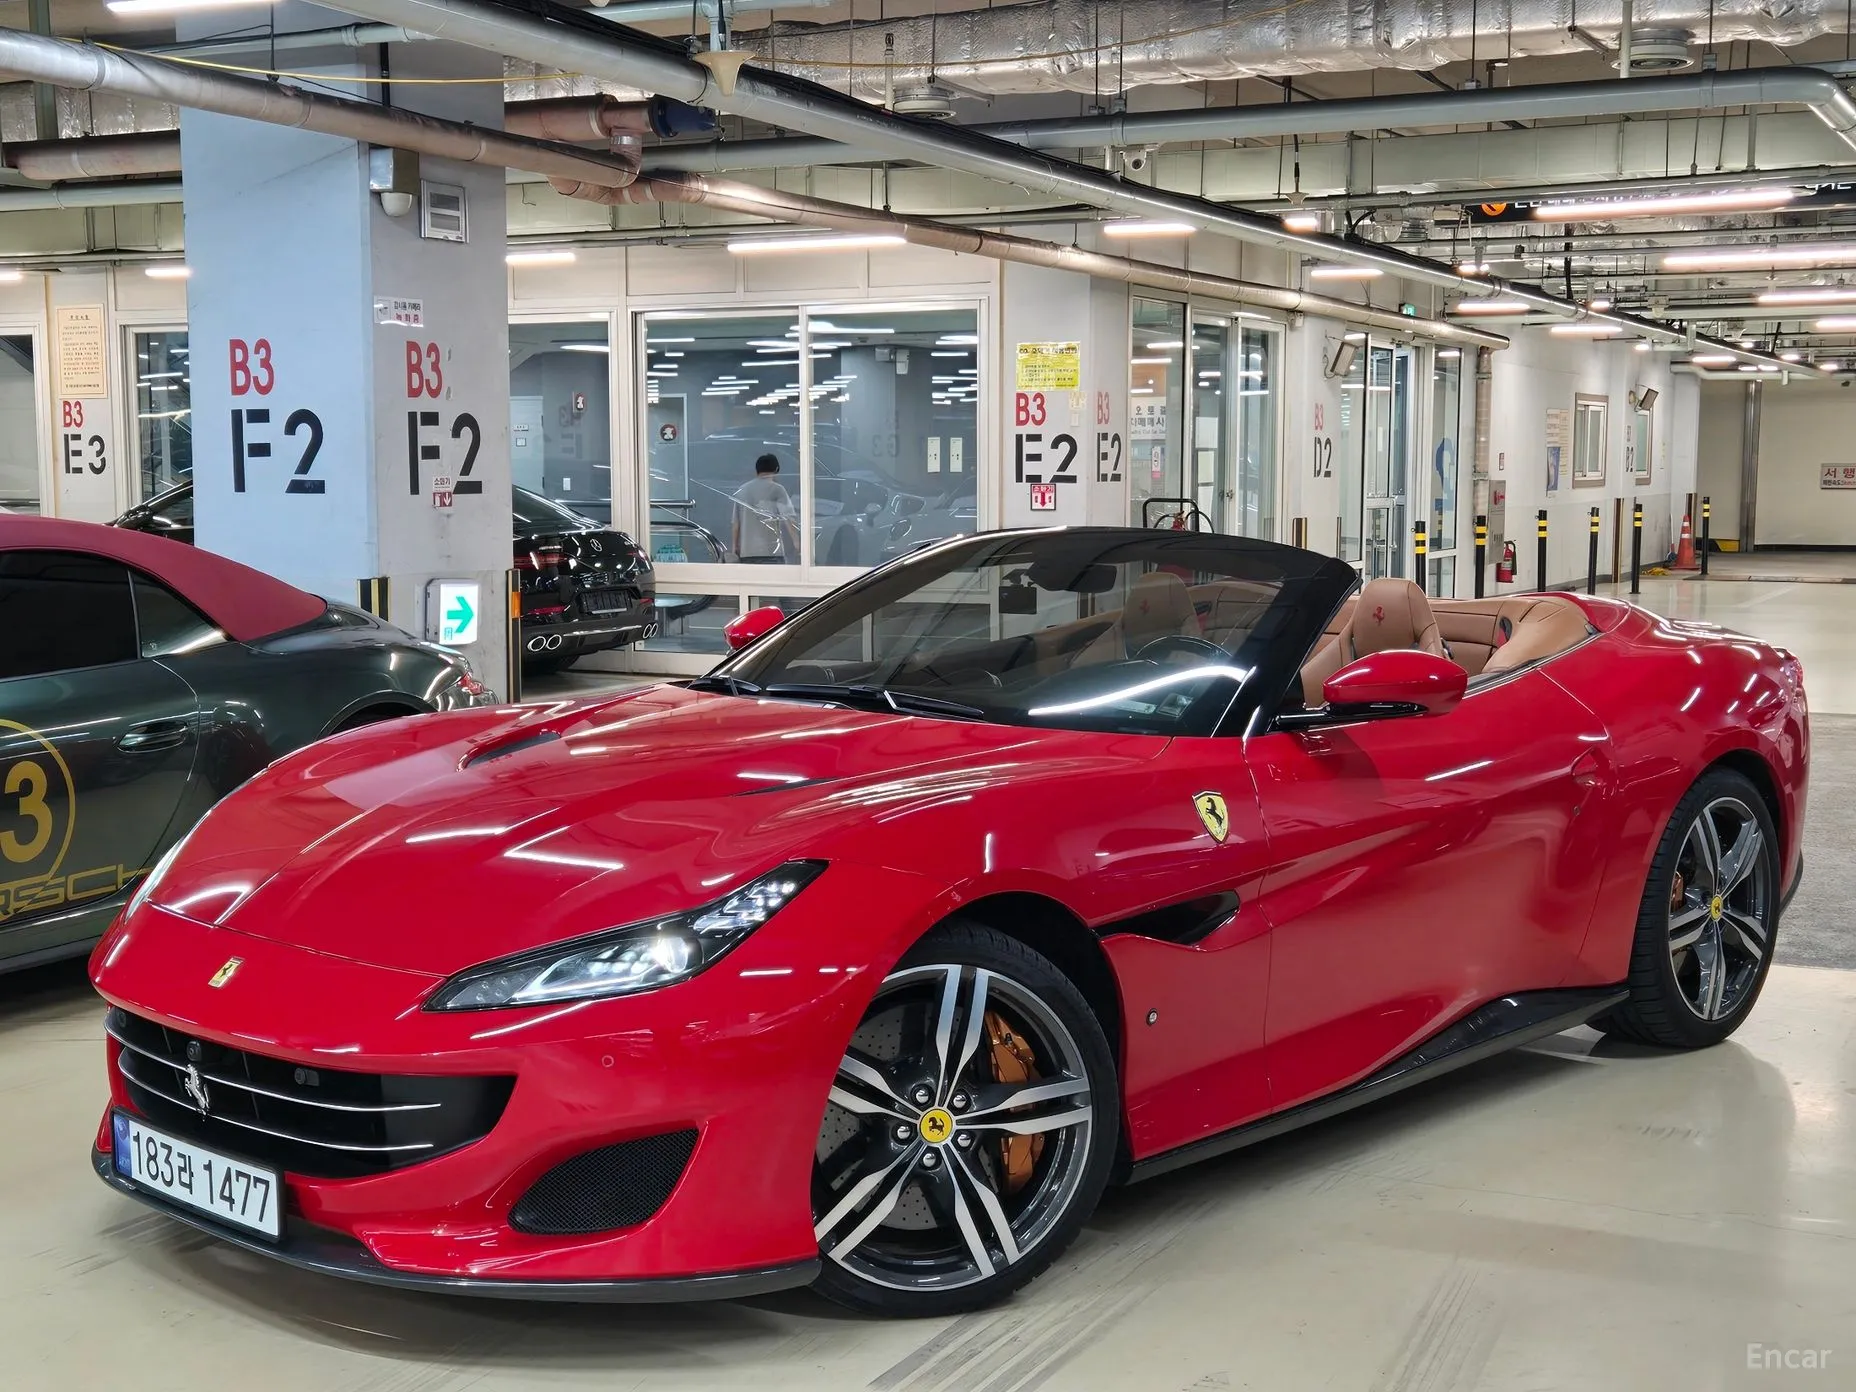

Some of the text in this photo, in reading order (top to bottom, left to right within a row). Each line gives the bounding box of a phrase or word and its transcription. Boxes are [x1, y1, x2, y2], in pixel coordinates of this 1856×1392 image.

[229, 338, 274, 396] B3
[406, 340, 443, 398] B3
[63, 400, 84, 428] B3
[1015, 392, 1047, 427] B3
[1097, 391, 1110, 425] B3
[63, 433, 107, 475] E3
[231, 408, 326, 495] F2
[408, 411, 483, 496] F2
[1015, 433, 1078, 484] E2
[1097, 432, 1122, 482] E2
[1313, 436, 1332, 478] D2
[0, 760, 53, 863] 3
[132, 1131, 270, 1224] 183라 1477
